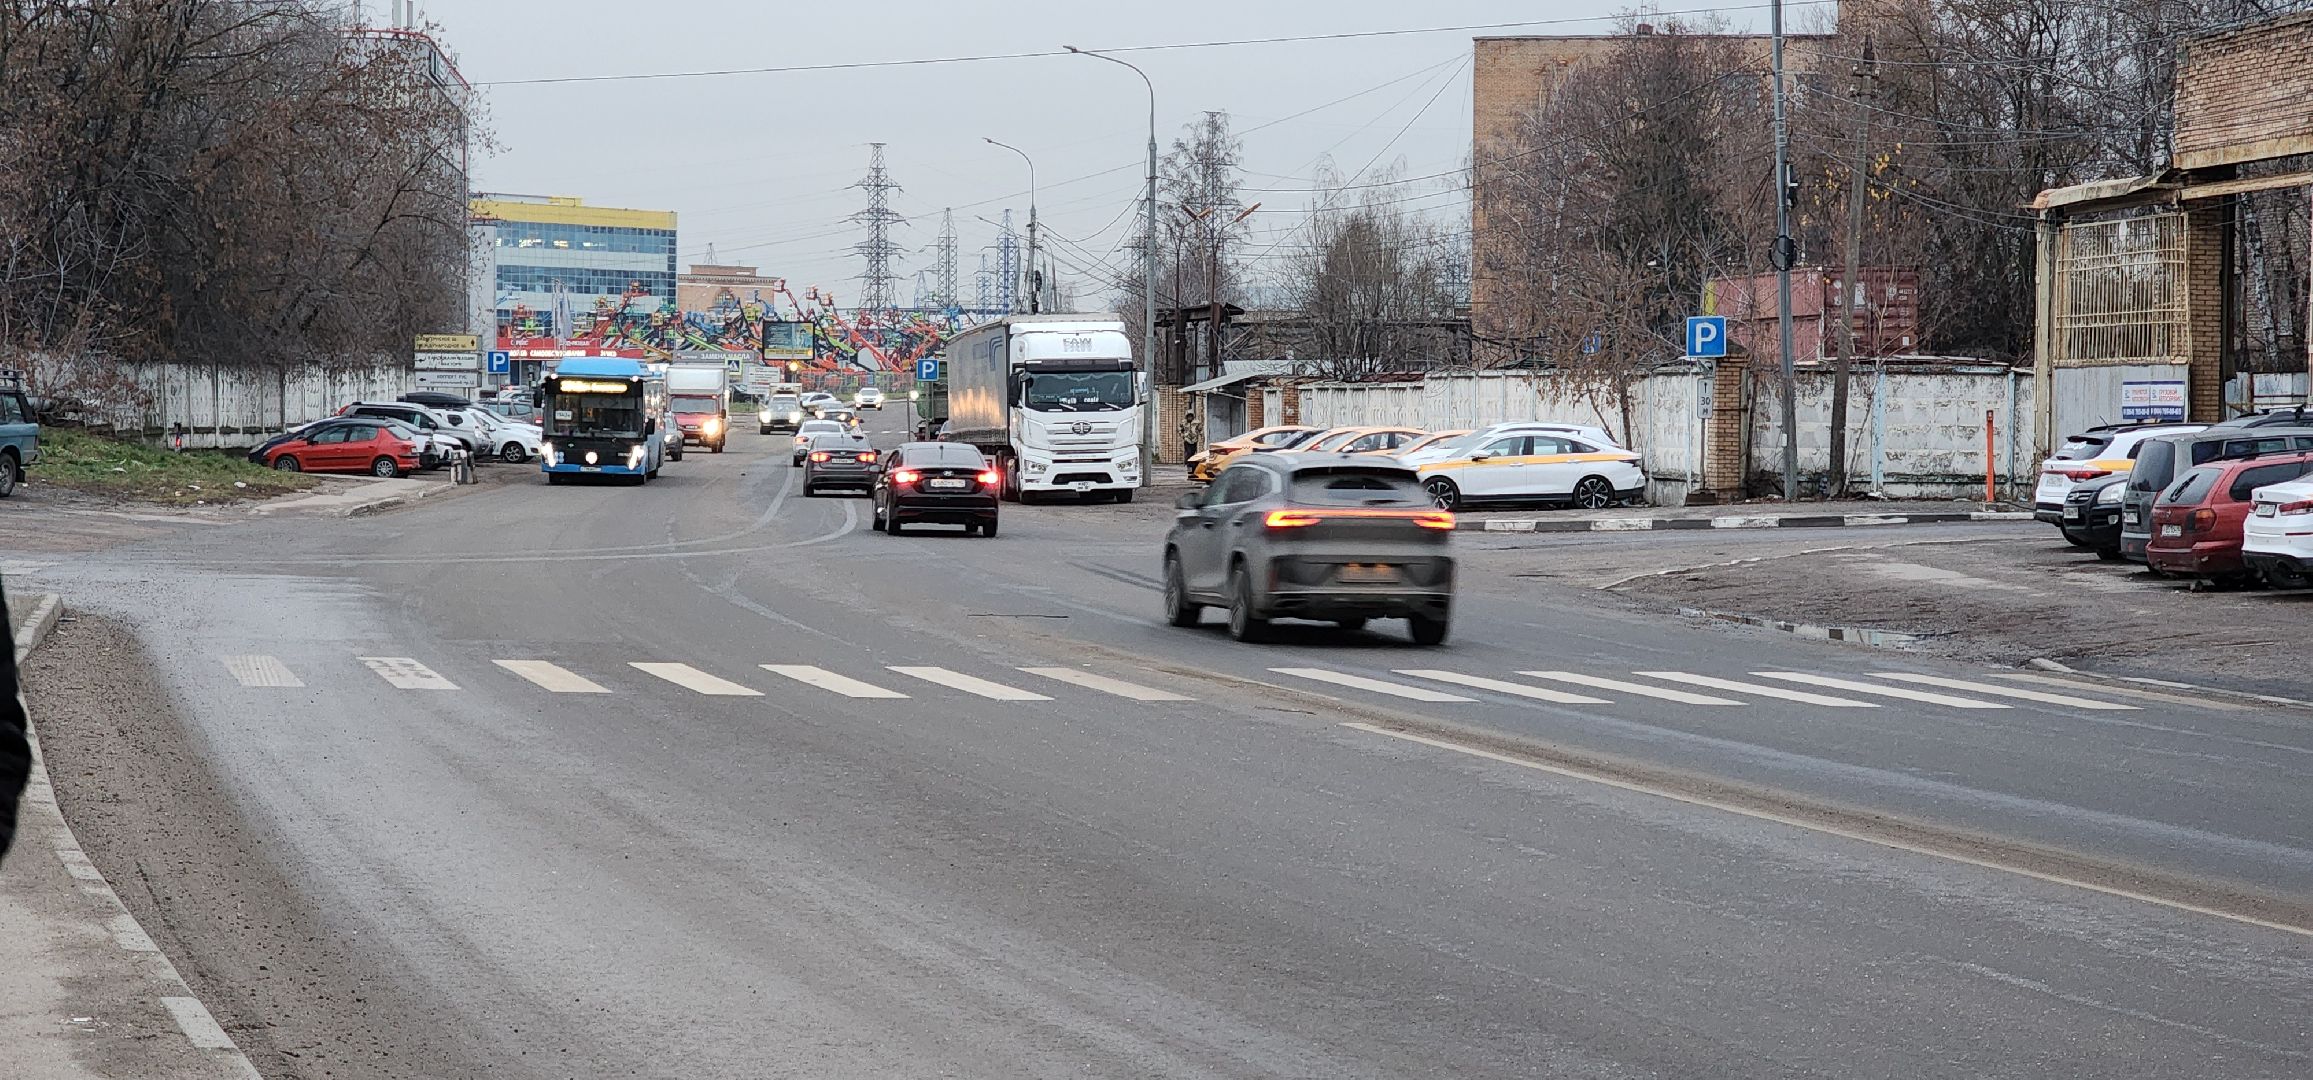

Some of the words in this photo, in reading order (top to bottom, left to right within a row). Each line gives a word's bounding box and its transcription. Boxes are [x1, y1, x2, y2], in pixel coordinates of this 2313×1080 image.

[1695, 321, 1717, 353] P
[492, 353, 505, 370] P
[922, 361, 935, 379] P
[1700, 396, 1711, 406] 30
